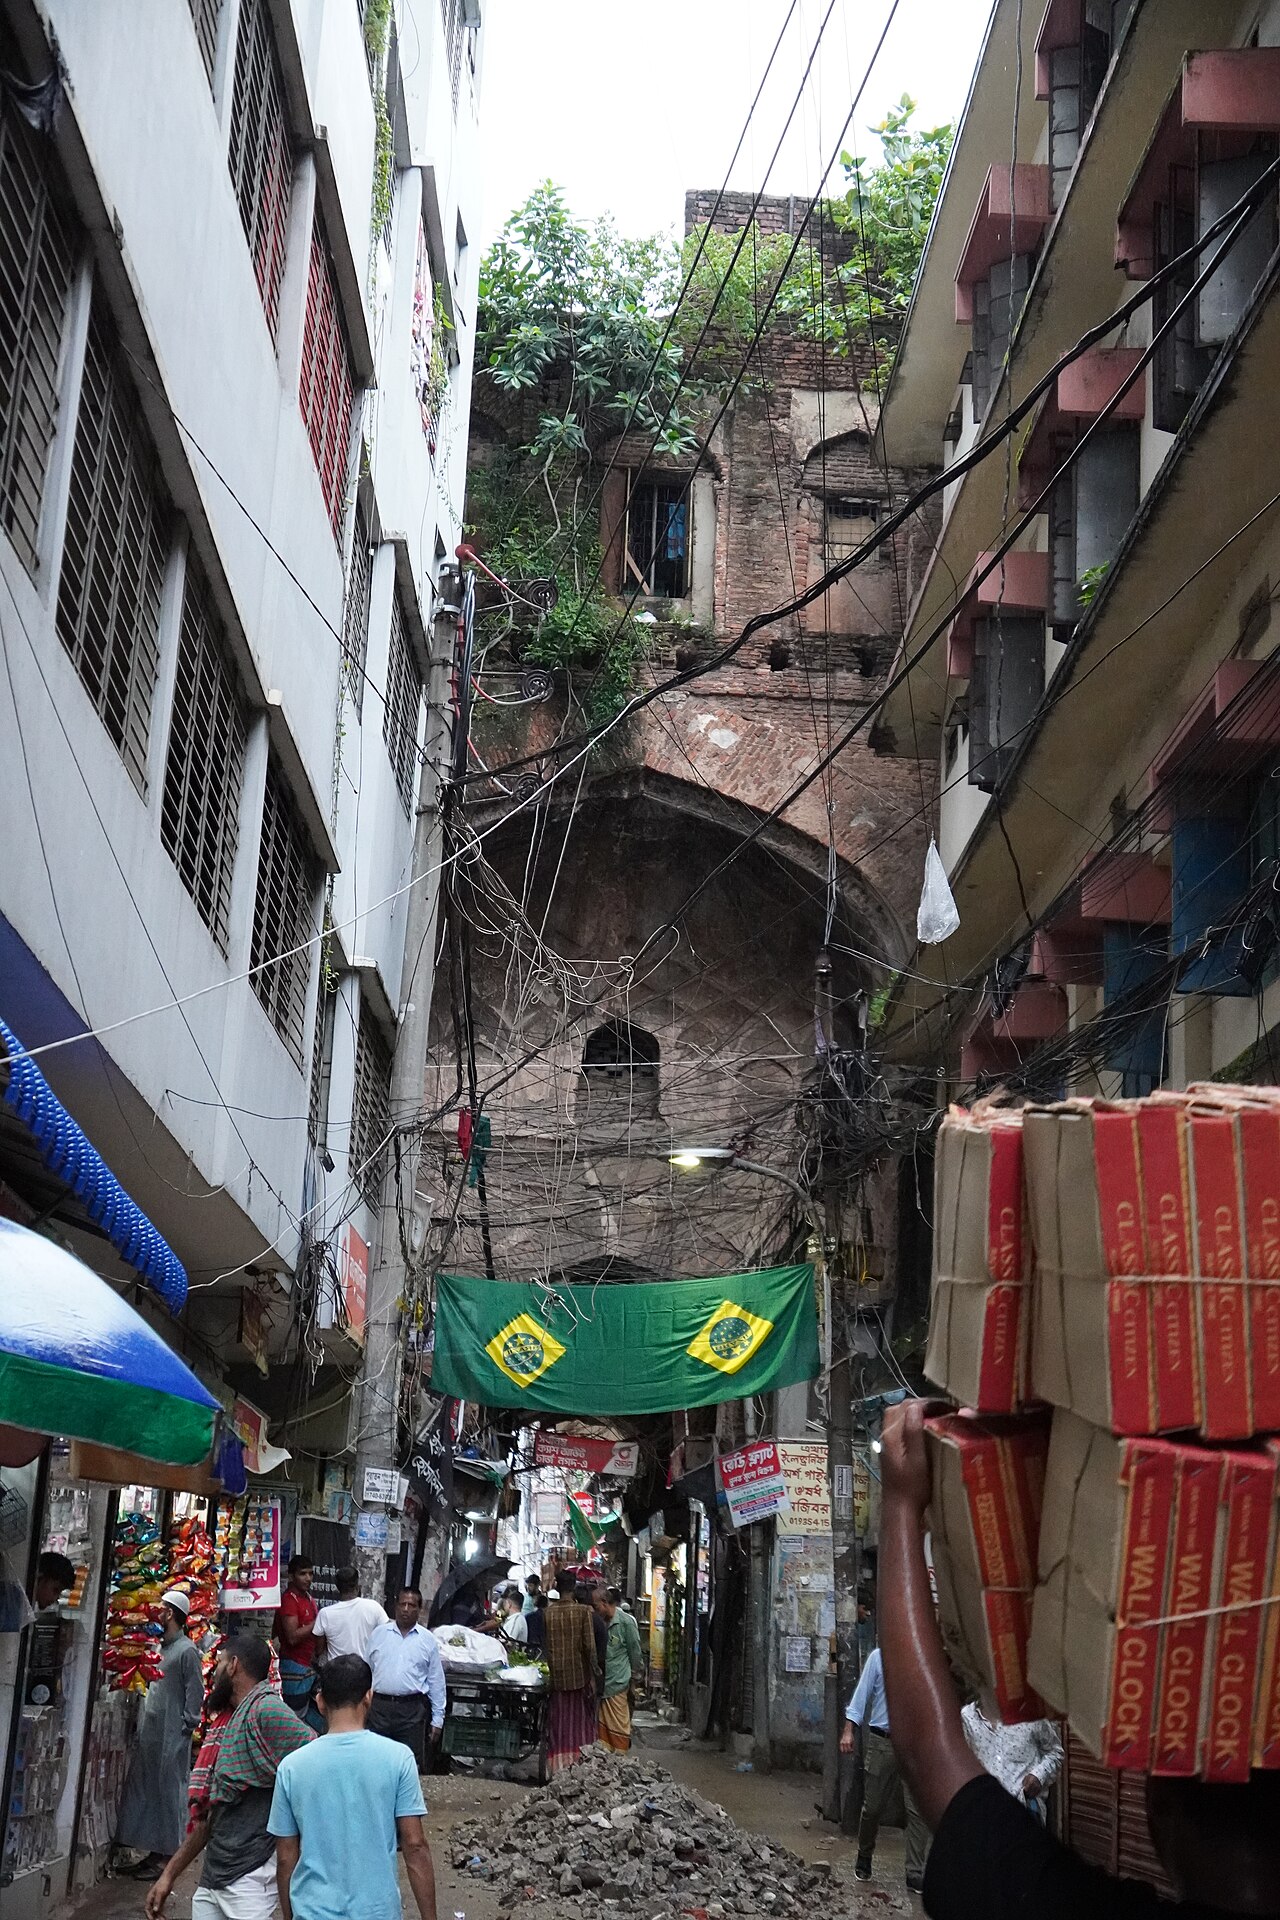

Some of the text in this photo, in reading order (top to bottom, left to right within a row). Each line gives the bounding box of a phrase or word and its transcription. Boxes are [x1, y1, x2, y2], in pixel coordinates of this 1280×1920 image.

[1000, 1206, 1016, 1299] CLASSC
[1159, 1193, 1184, 1299] CLASSC
[1260, 1198, 1280, 1302] CLASSC
[722, 1452, 747, 1474] রেডি
[1125, 1544, 1158, 1626] WALL
[1172, 1553, 1203, 1638] WALL
[1223, 1560, 1256, 1646] WALL
[1115, 1637, 1149, 1745] CLOCK
[1163, 1646, 1195, 1751] CLOCK
[1214, 1653, 1246, 1760] CLOCK
